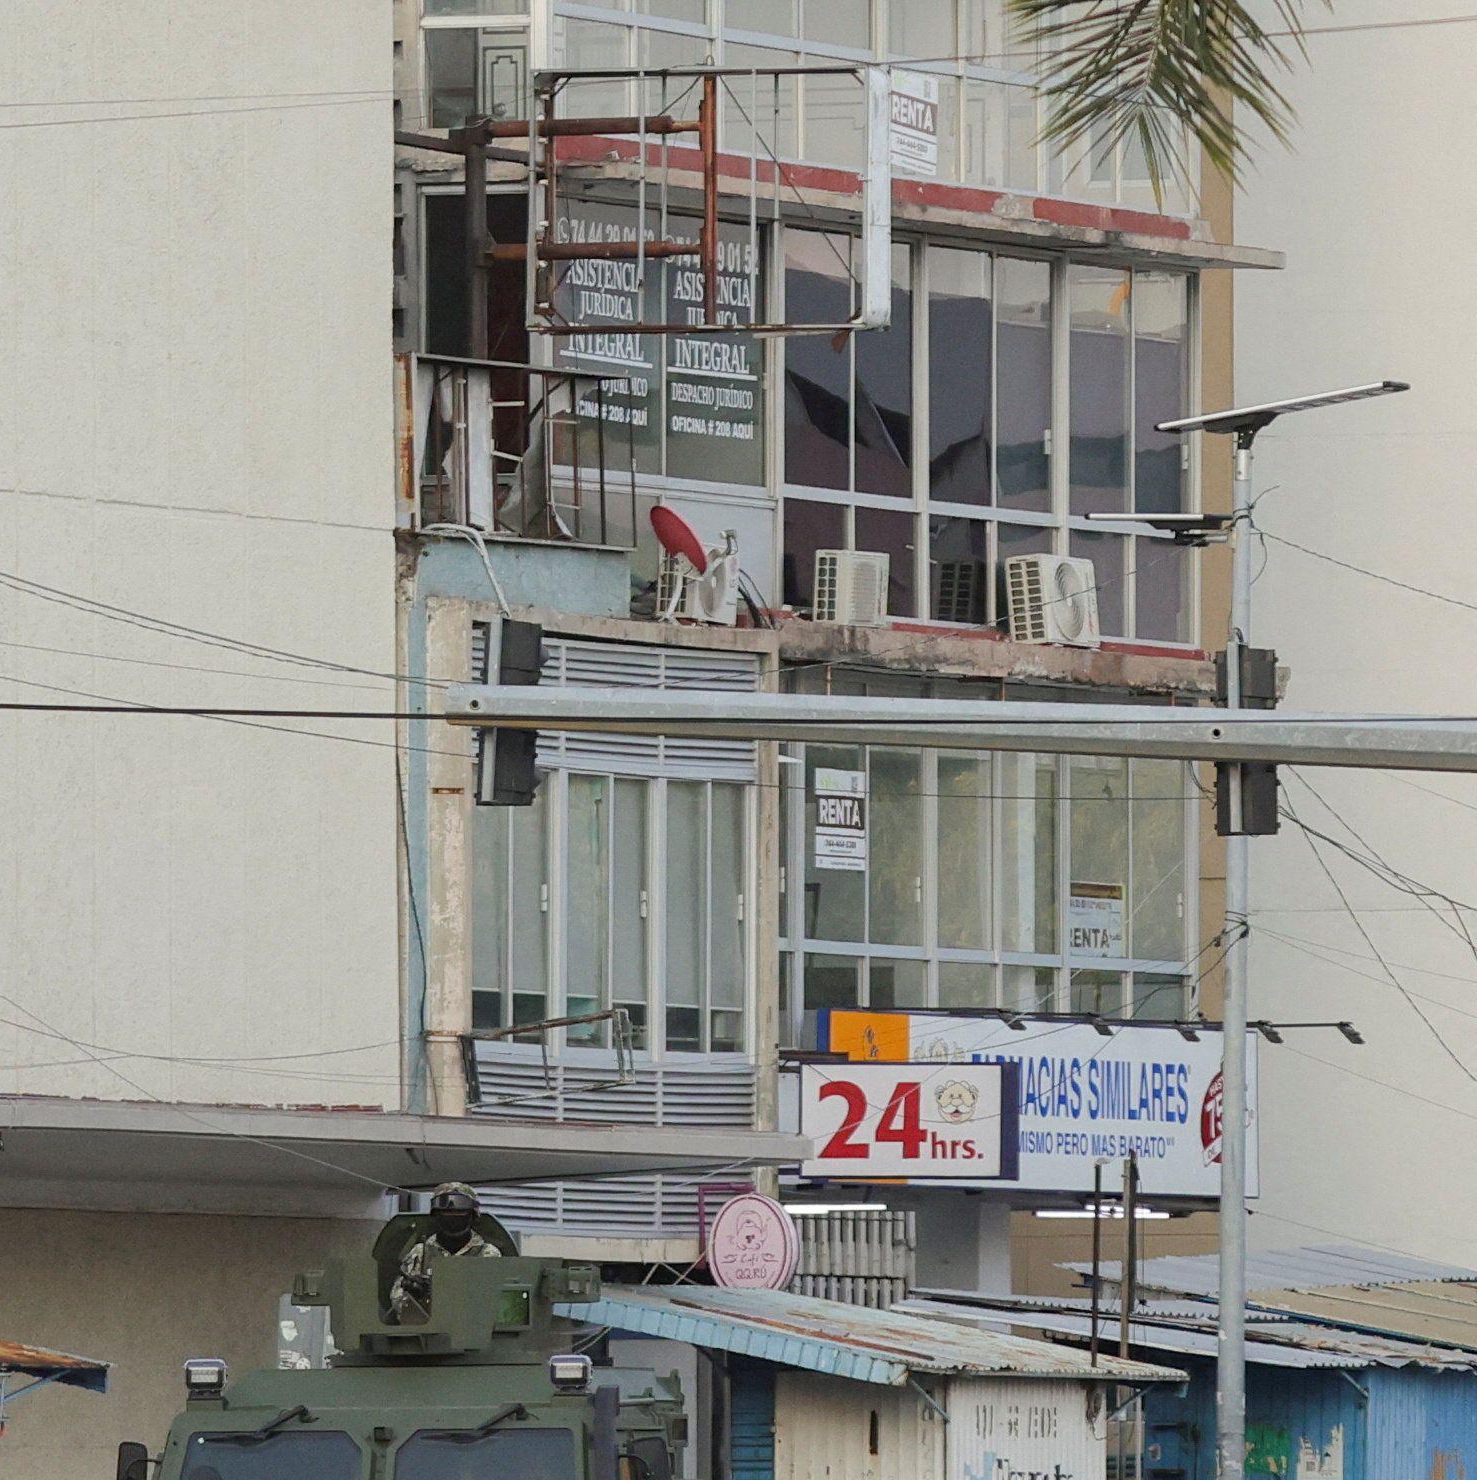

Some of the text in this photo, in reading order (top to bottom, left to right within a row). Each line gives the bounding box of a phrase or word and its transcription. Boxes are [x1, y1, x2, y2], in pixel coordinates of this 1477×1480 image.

[891, 94, 934, 132] RENTA
[579, 287, 634, 322] JURÍDICA
[567, 322, 645, 361] INTEGRAL
[674, 338, 750, 374] INTEGRAL
[671, 382, 753, 411] DESPACHO JURÍDICO
[672, 415, 707, 433] OFICINA
[715, 422, 732, 437] 208
[732, 420, 754, 440] AQUÍ
[819, 798, 861, 827] RENTA
[1088, 1058, 1189, 1124] SIMILARES
[818, 1080, 985, 1160] 24 hrs.
[1057, 1132, 1089, 1155] PERO
[1092, 1134, 1117, 1156] MAS
[1120, 1135, 1166, 1159] BARATO
